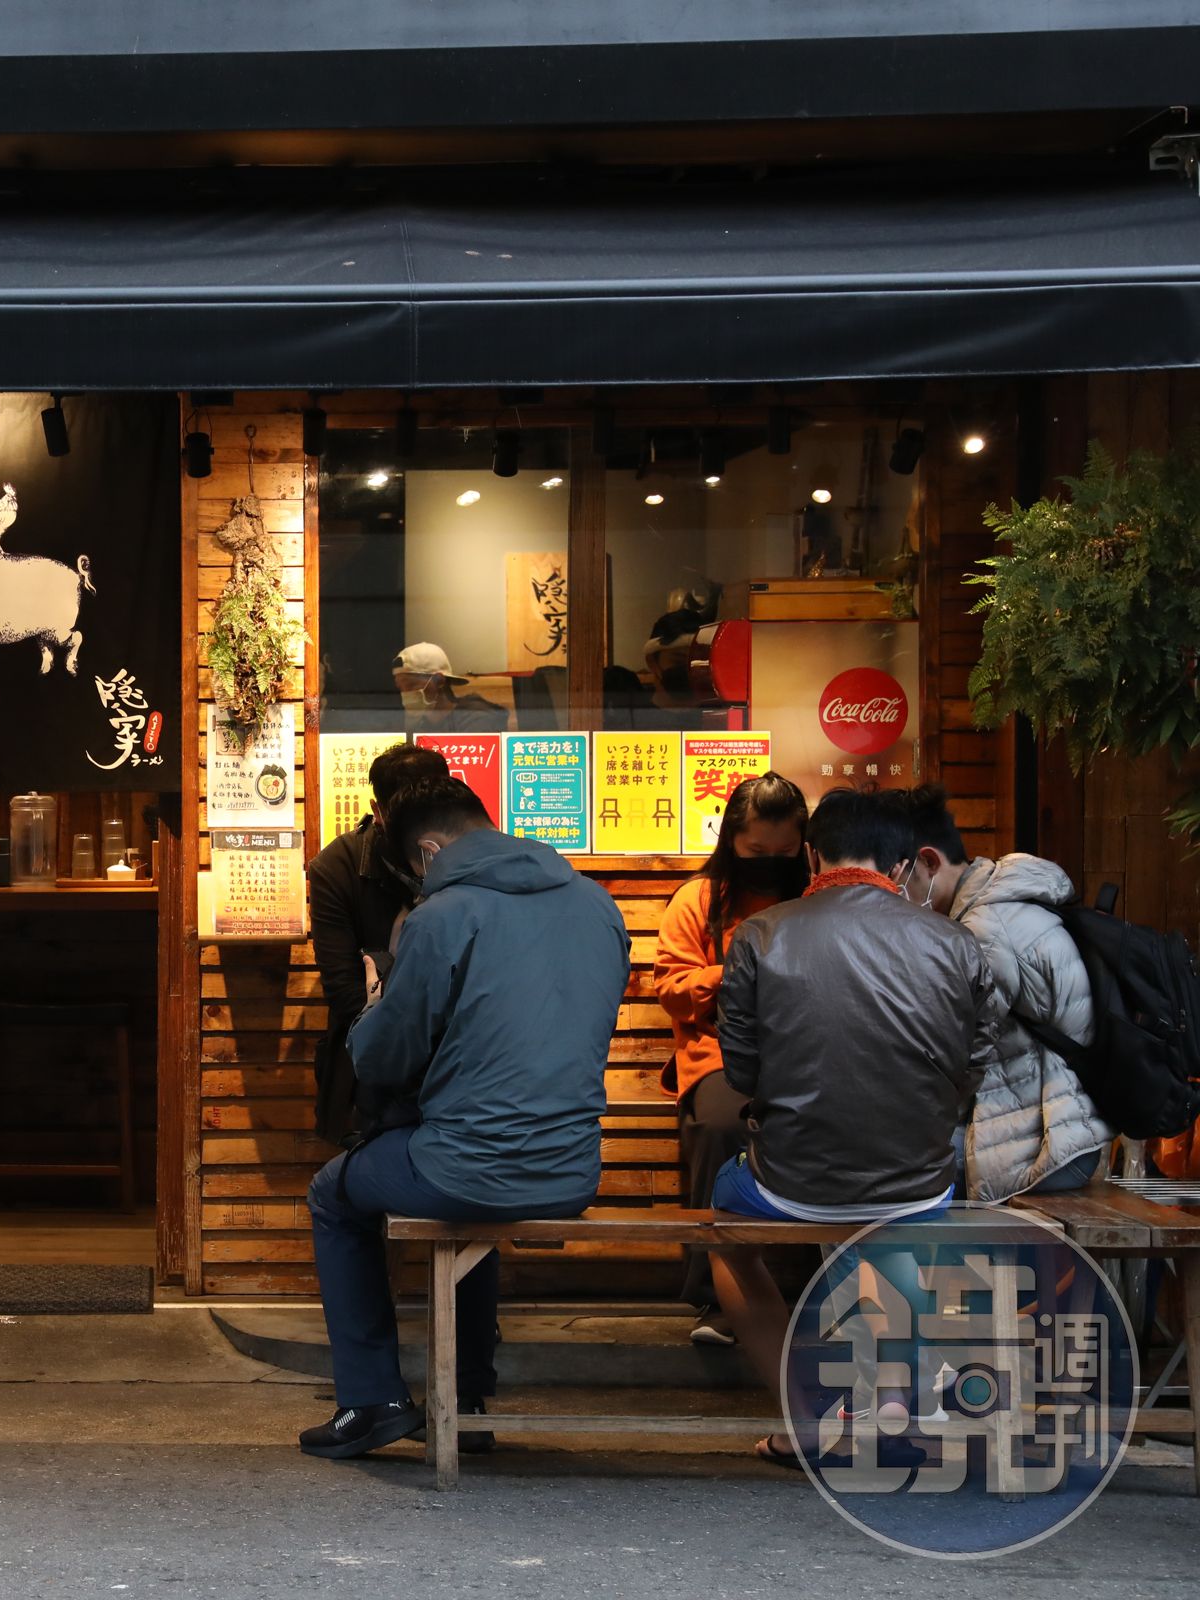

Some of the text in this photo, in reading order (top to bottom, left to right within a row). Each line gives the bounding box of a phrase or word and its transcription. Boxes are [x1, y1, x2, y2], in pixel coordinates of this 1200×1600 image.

[822, 697, 904, 723] Coca-Cola
[333, 746, 388, 756] いつもよ
[432, 745, 485, 754] テイクアウト
[513, 741, 579, 754] 食で活力を!
[607, 744, 668, 754] いつもより
[131, 753, 163, 767] ラーメン
[513, 755, 579, 766] 元気に営業中
[606, 760, 668, 771] 席を離して
[697, 758, 757, 767] マスクの下は
[821, 764, 902, 776] 勁享暢快
[606, 775, 668, 786] 営業中です
[514, 817, 579, 826] 安全確保の為に
[514, 827, 580, 838] 精一杯対策中
[334, 1409, 356, 1431] PUMA
